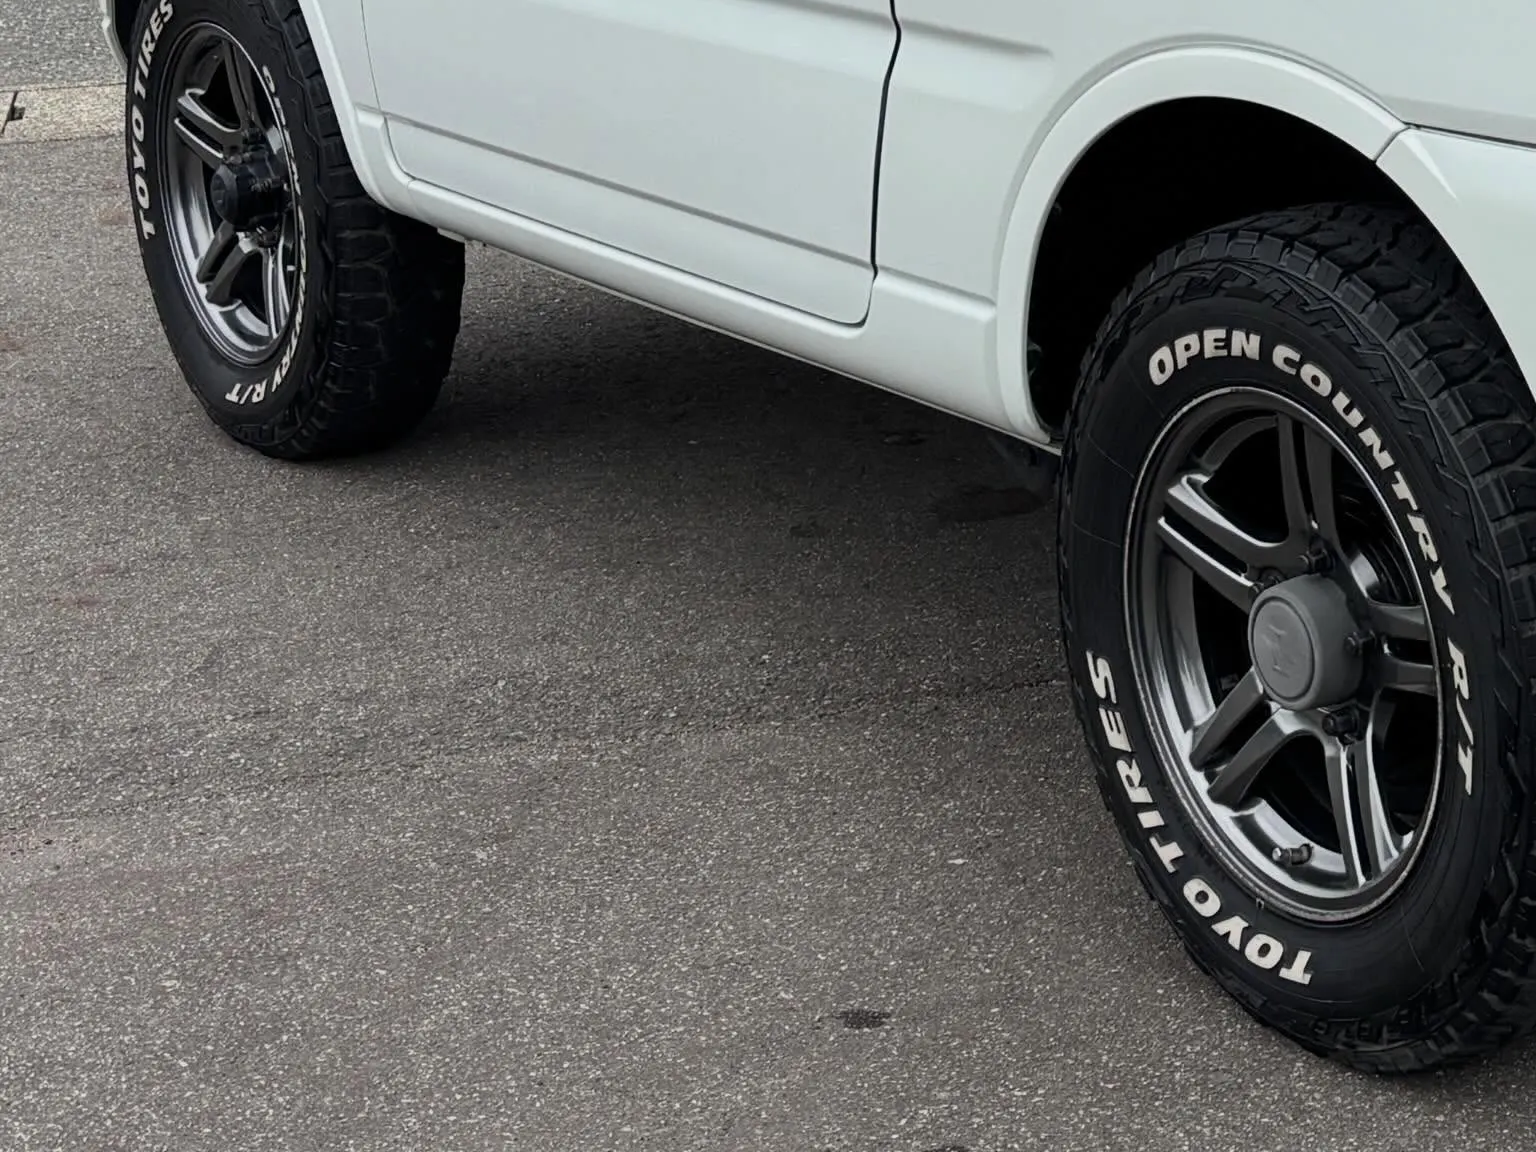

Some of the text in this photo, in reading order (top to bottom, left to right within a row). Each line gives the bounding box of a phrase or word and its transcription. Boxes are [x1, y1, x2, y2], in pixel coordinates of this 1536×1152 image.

[132, 103, 156, 241] TOYO
[1149, 327, 1475, 797] OPEN COUNTRY R/T
[1086, 649, 1314, 986] TOYO TIRES
